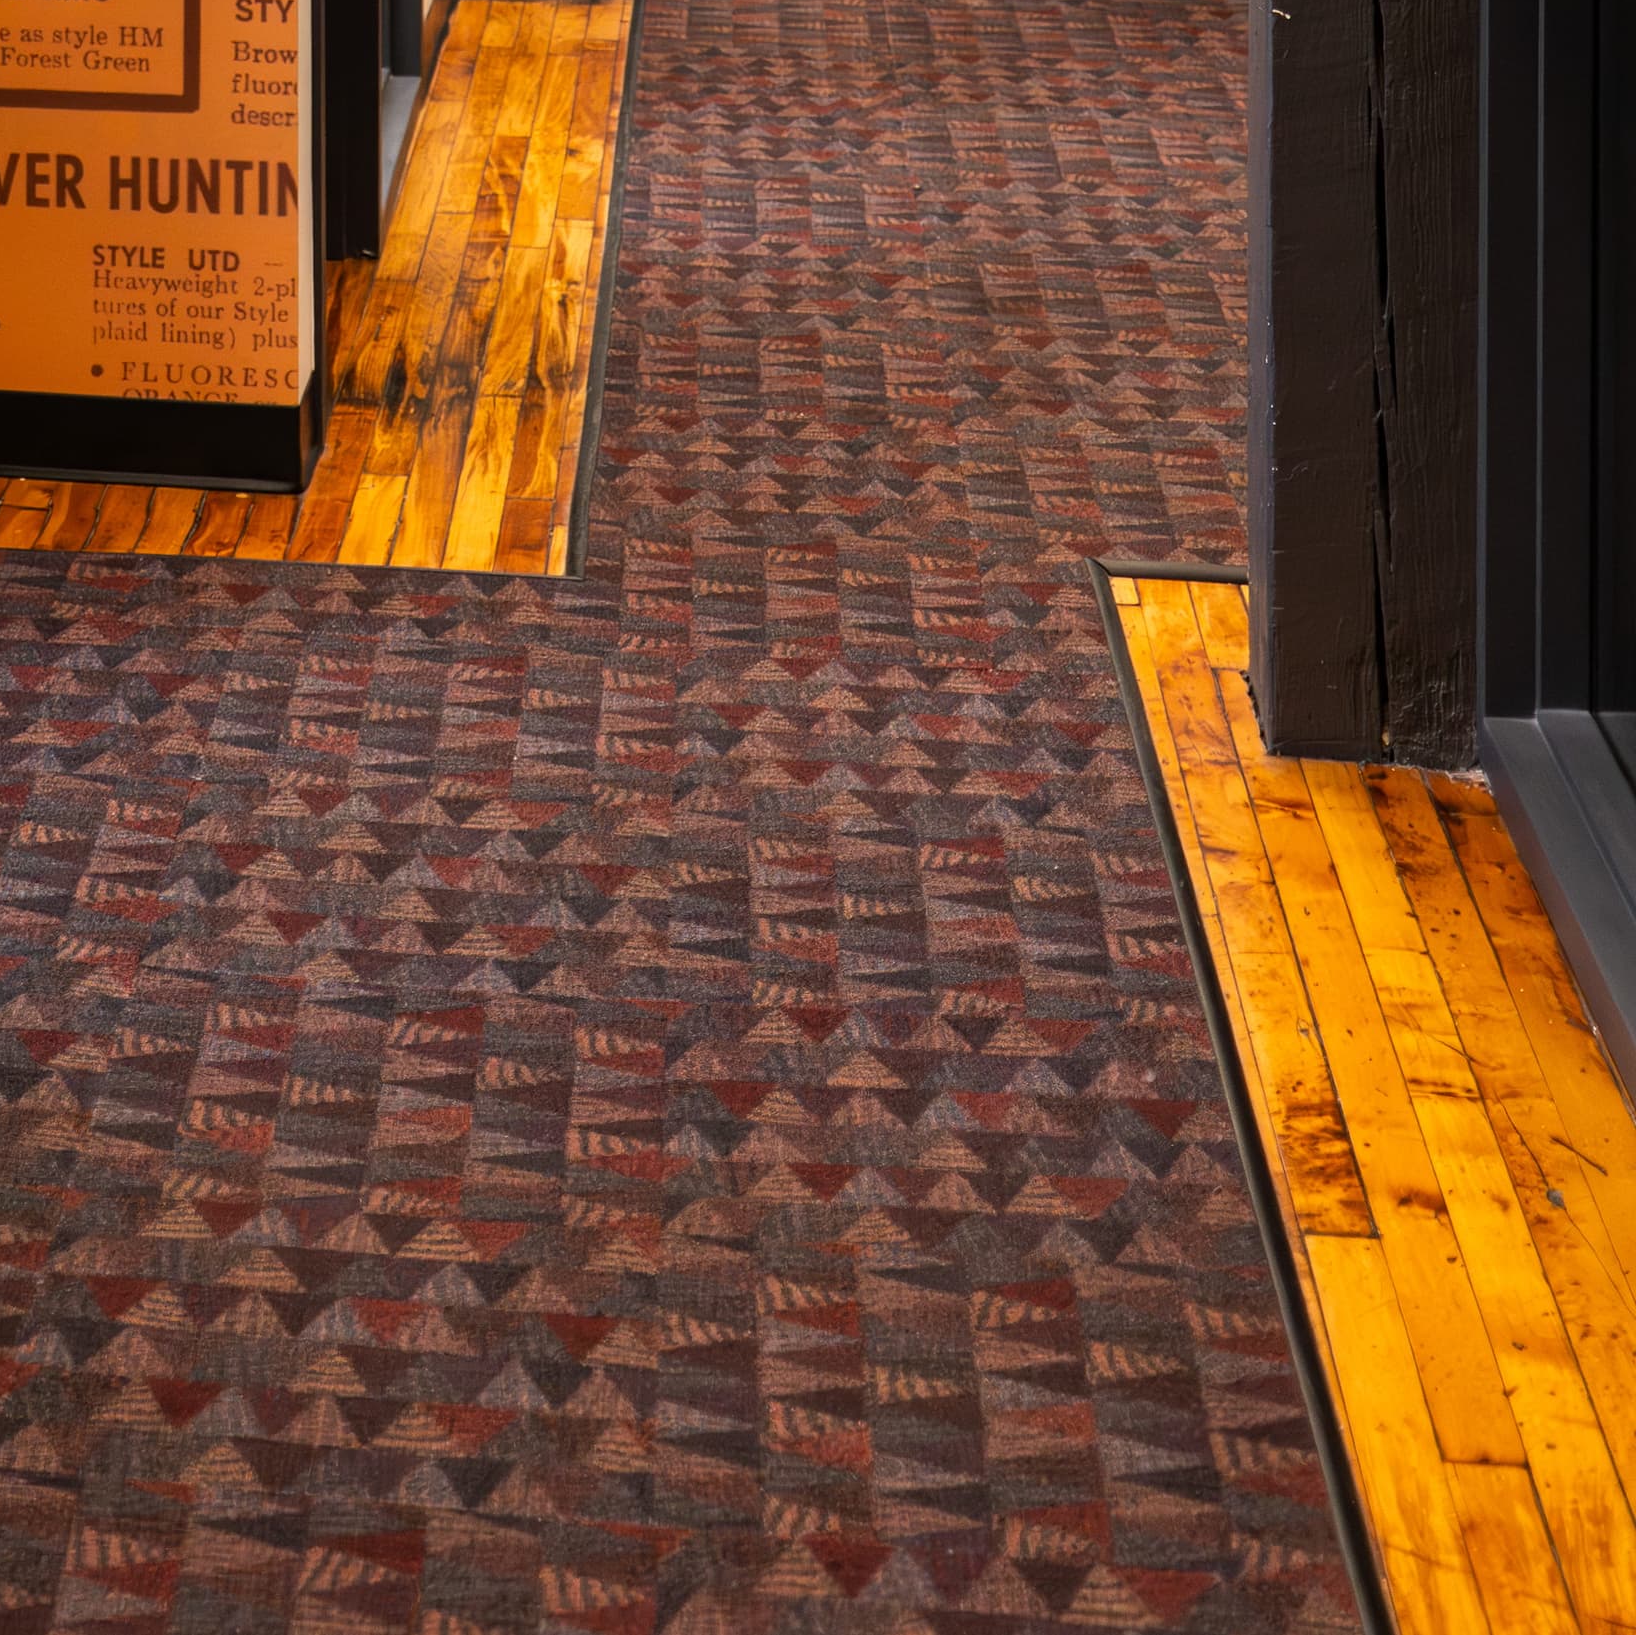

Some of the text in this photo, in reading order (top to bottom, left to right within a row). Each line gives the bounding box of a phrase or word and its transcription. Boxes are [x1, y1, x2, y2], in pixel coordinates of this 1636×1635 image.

[20, 29, 44, 42] as
[53, 25, 108, 50] style
[119, 26, 163, 48] HM
[0, 46, 71, 68] Forest
[83, 50, 150, 72] Green
[231, 41, 298, 64] Brow
[92, 243, 166, 269] STYLE
[188, 248, 241, 271] UTD
[94, 269, 237, 298] Heavyweight
[94, 298, 288, 325] tures of our Style
[93, 320, 298, 352] plaid lining) plus
